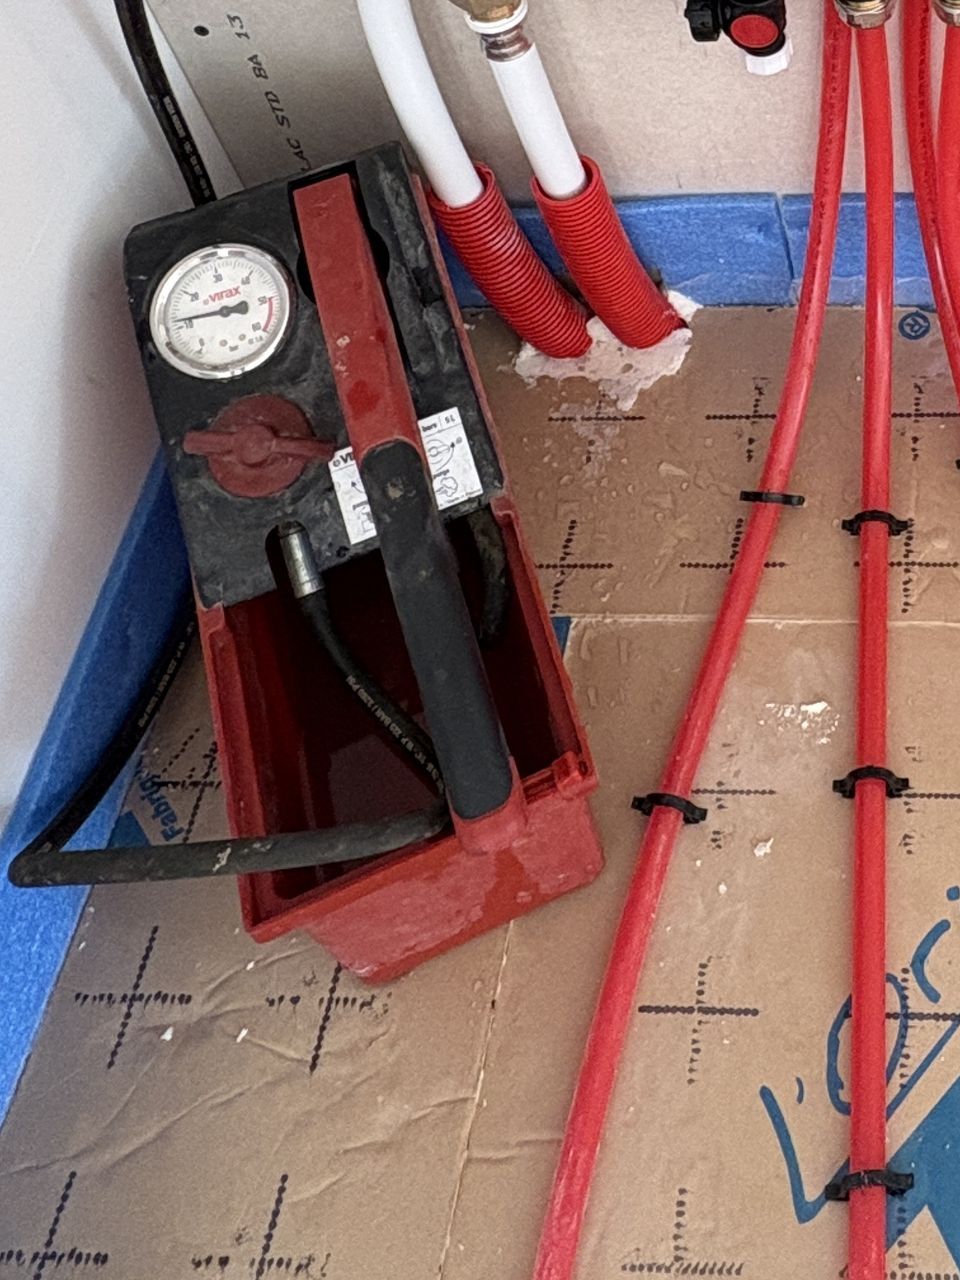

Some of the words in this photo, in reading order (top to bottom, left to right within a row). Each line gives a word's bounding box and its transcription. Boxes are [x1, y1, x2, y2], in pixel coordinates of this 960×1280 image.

[226, 13, 250, 40] 13
[247, 54, 269, 81] BA
[265, 90, 291, 129] STD
